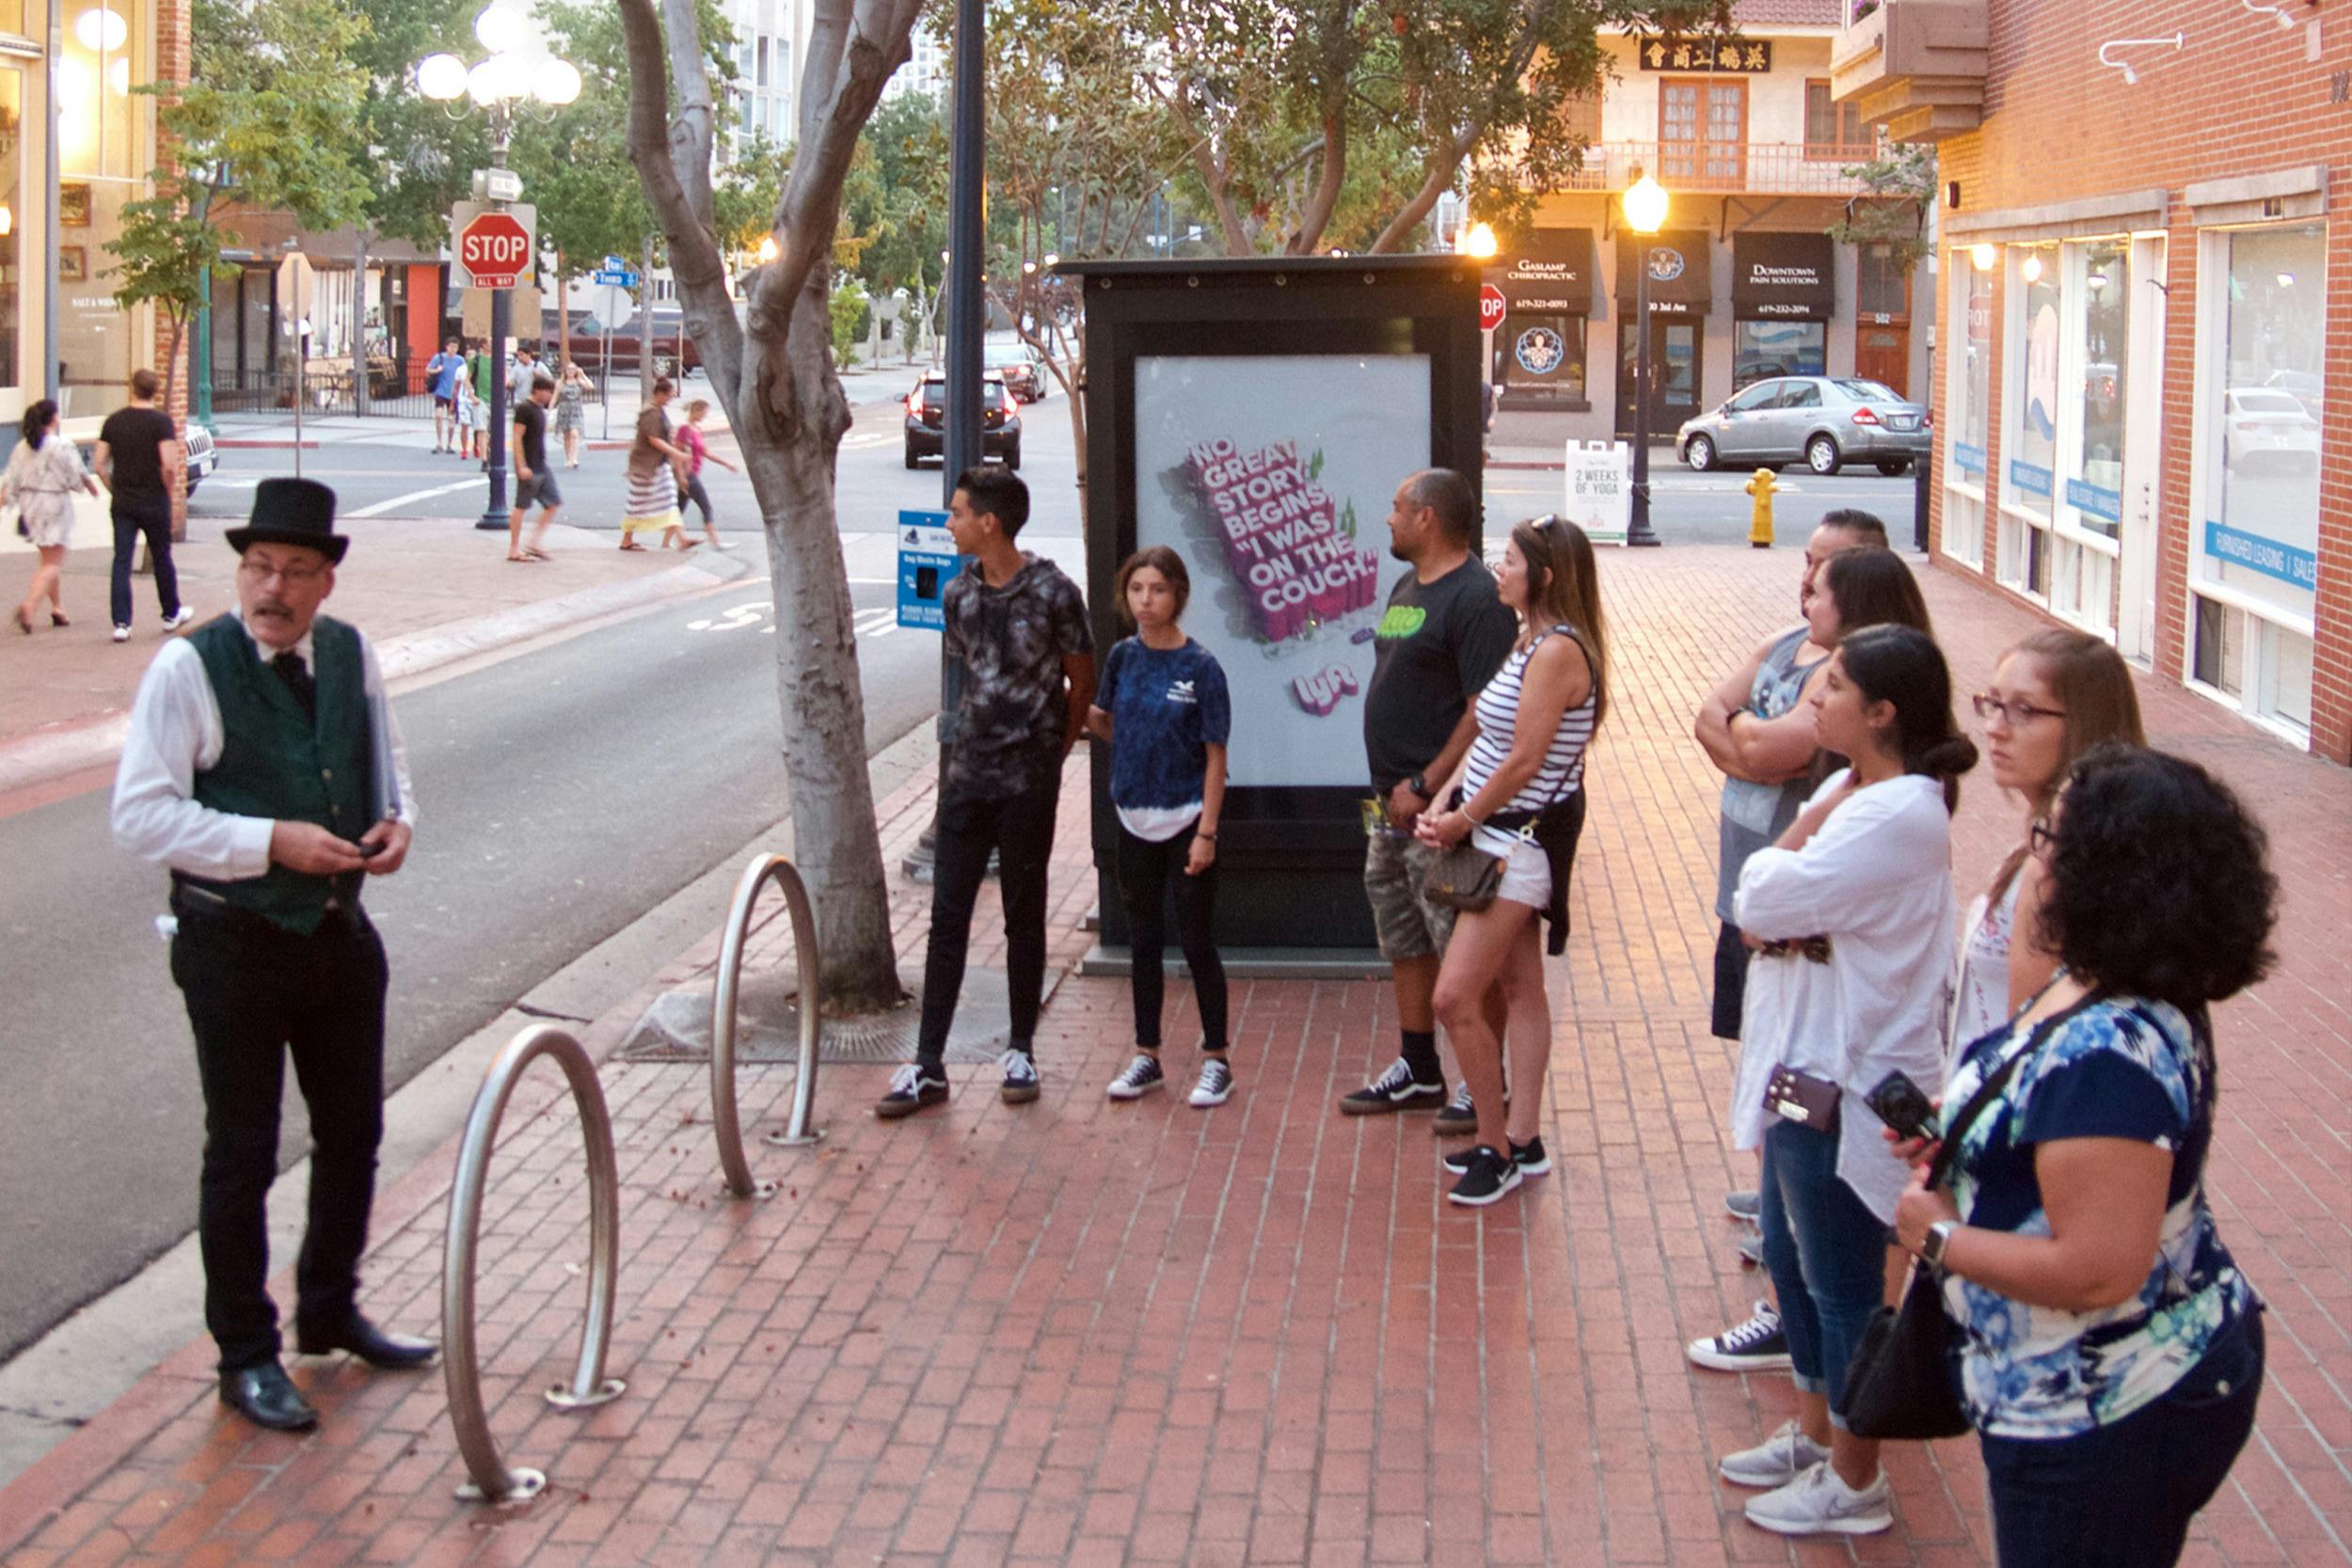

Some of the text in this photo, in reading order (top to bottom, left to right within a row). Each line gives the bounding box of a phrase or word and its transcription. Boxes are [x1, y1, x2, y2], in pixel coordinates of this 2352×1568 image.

[465, 235, 526, 263] STOP
[1518, 259, 1566, 272] GASLAMP
[1753, 263, 1816, 277] DOWNTOWN
[496, 276, 513, 287] WAY
[1507, 272, 1577, 280] CHIROPRACTIC
[1771, 277, 1820, 285] SOLUTIONS
[1480, 297, 1503, 318] OP
[1190, 436, 1234, 467] NO
[1203, 439, 1297, 488] GREAT
[1575, 469, 1619, 482] 2 WEEKS
[1214, 465, 1305, 513] STORY
[1575, 483, 1619, 495] OF YOGA
[1263, 511, 1331, 550] WAS
[1248, 531, 1355, 586] ON THE
